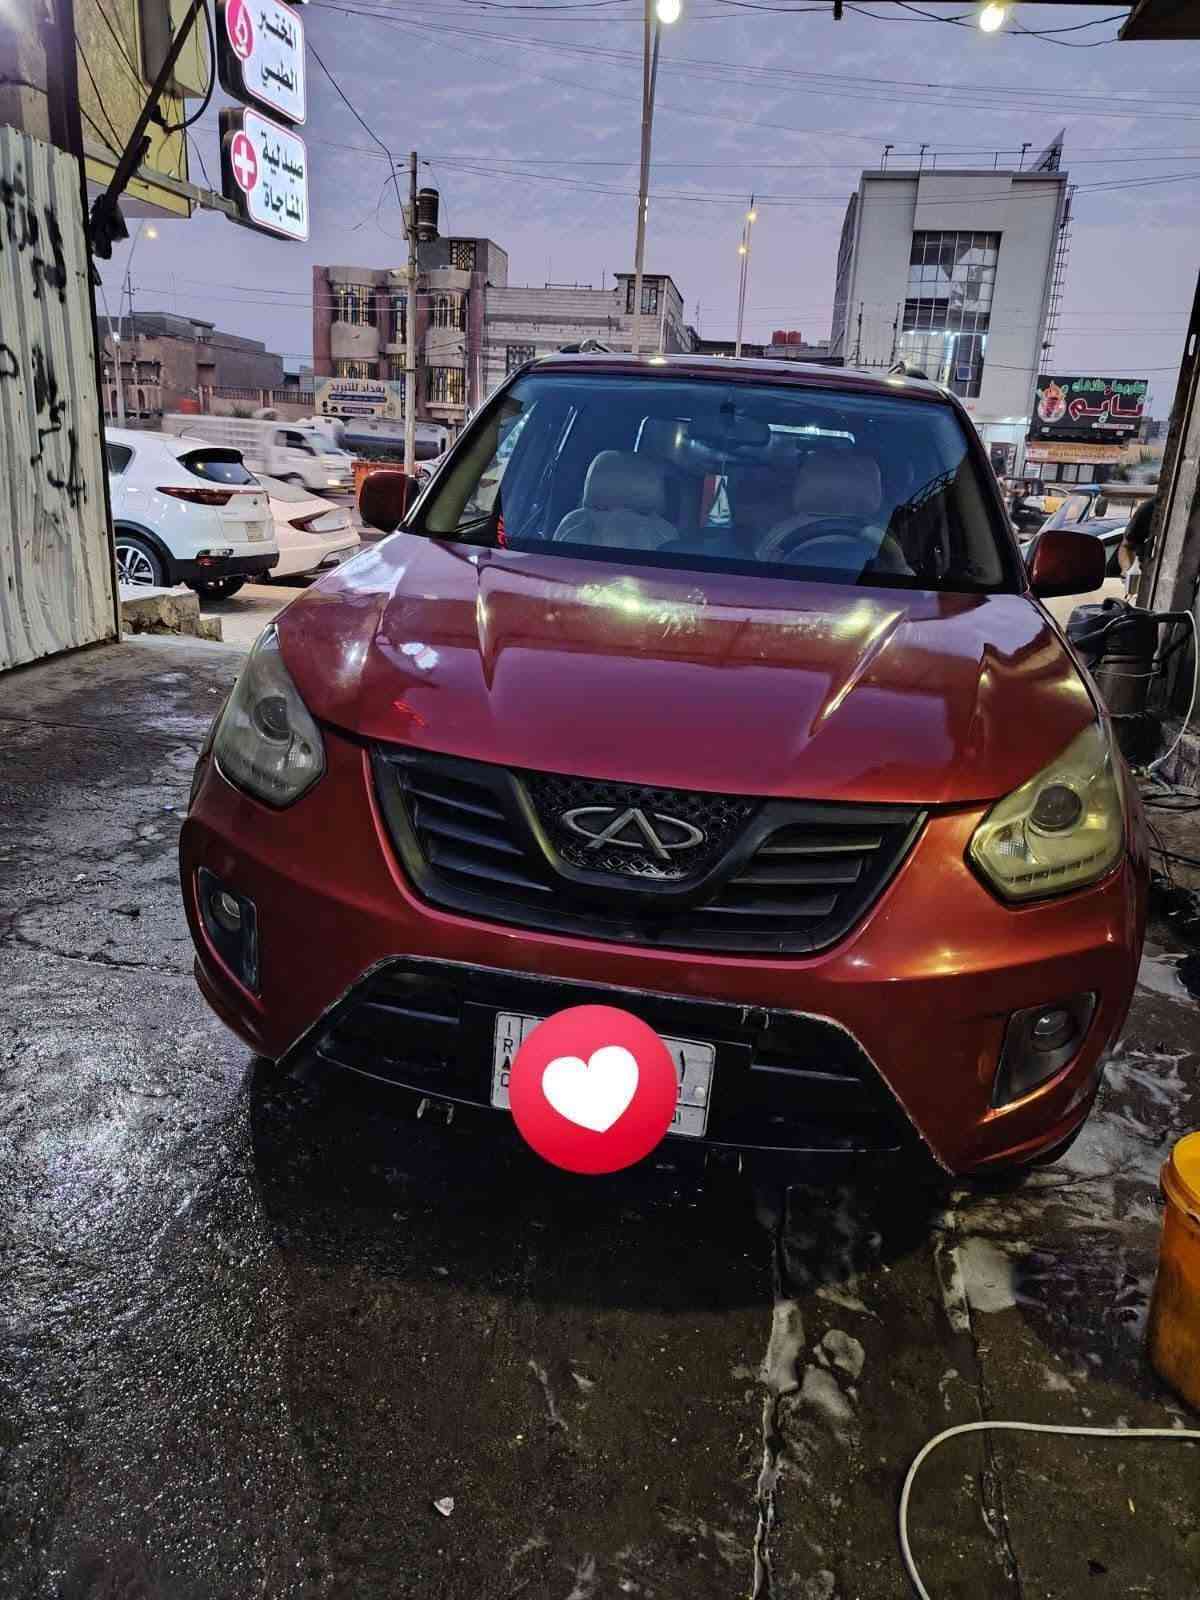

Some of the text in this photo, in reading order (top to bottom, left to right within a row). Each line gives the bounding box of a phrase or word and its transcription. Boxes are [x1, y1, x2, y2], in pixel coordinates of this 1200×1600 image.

[258, 10, 297, 49] المختبر
[260, 59, 298, 93] الطبي
[260, 131, 304, 183] صيدلية
